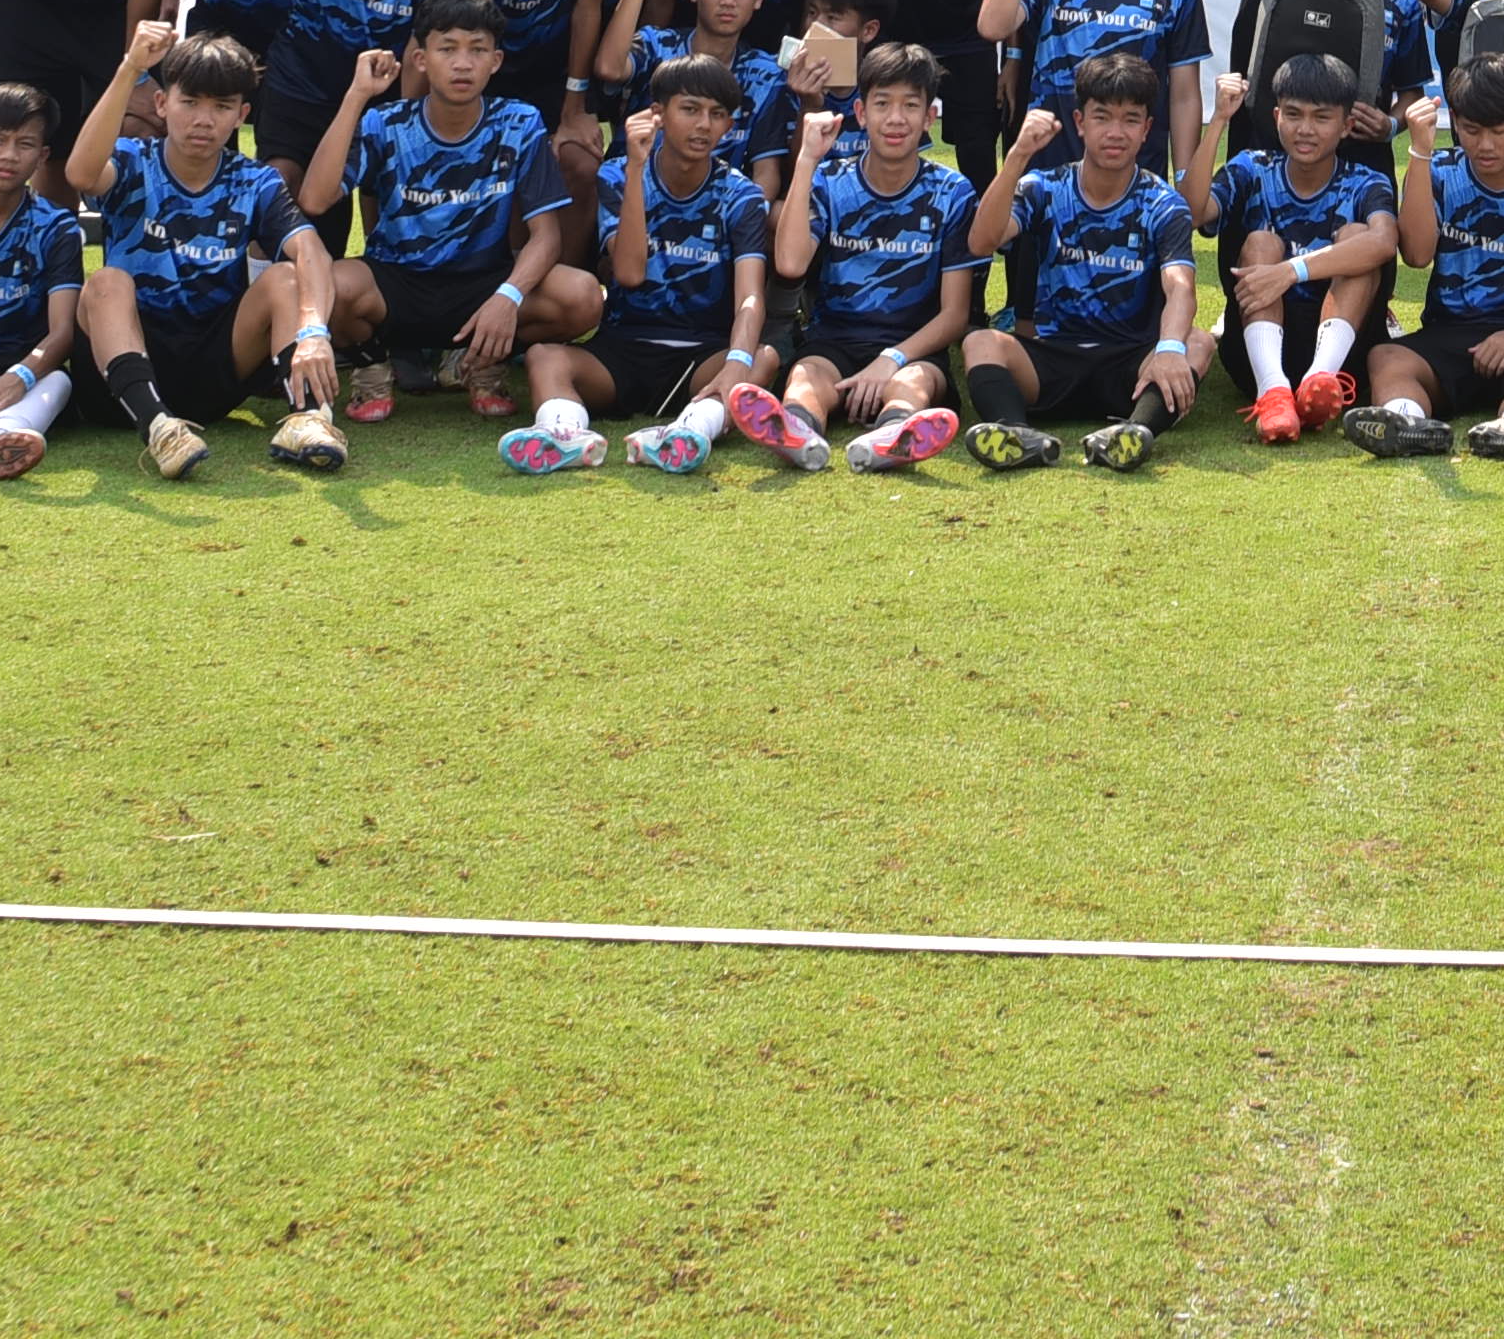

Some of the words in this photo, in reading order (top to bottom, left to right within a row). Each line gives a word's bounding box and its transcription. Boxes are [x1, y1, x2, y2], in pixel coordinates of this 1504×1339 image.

[1054, 6, 1093, 24] Know
[1095, 9, 1126, 28] You
[1128, 14, 1157, 32] Can
[399, 185, 447, 204] Know
[485, 181, 507, 196] an
[664, 241, 693, 259] You
[696, 246, 720, 262] Can
[829, 231, 873, 252] Know
[876, 236, 908, 253] You
[1087, 249, 1122, 270] You
